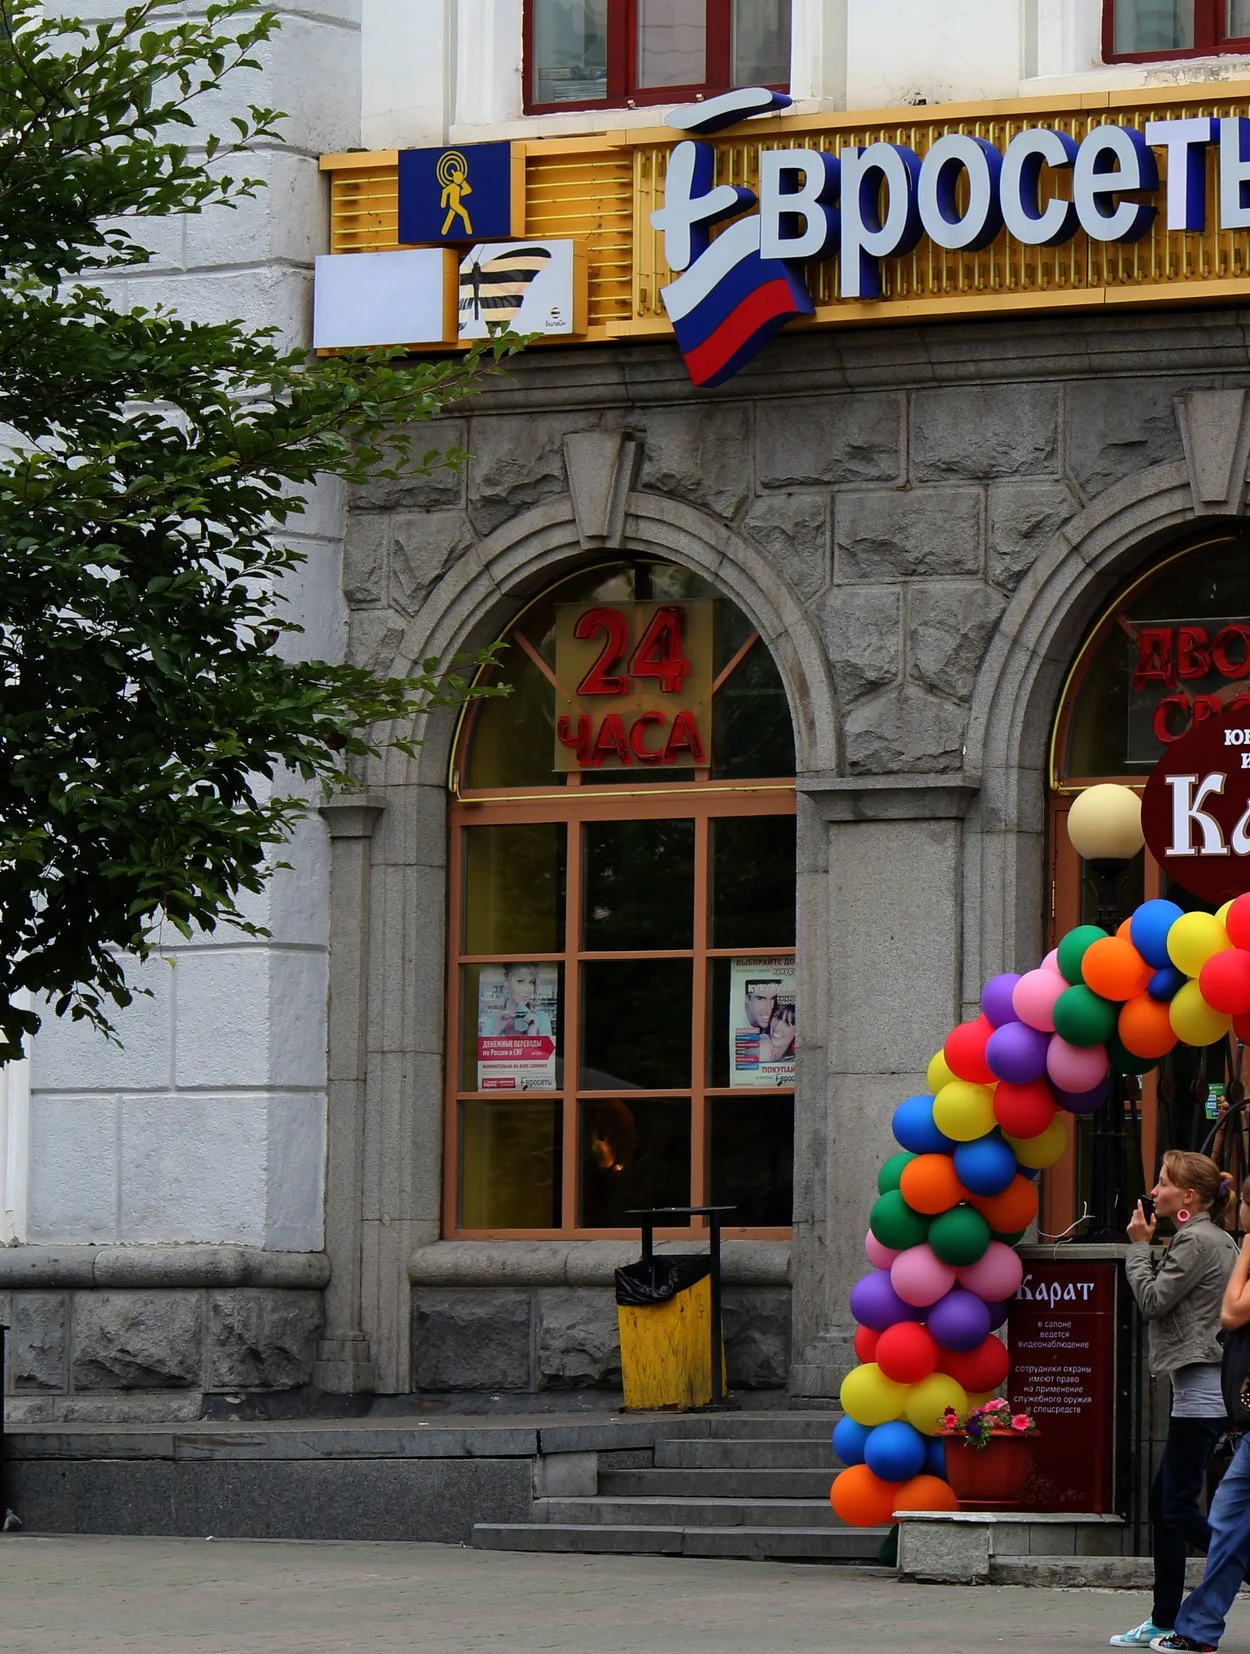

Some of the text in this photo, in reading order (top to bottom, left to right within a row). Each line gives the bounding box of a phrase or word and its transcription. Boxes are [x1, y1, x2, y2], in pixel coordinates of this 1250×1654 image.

[573, 605, 691, 696] 24
[557, 711, 706, 767] ЧАСА
[1015, 1274, 1095, 1309] Карат
[1018, 1340, 1090, 1348] видеонаблюдение
[1014, 1365, 1092, 1374] сотрудники охраны
[1056, 1376, 1080, 1384] право
[1035, 1386, 1084, 1394] применение
[1013, 1395, 1092, 1405] служебного оружия
[1033, 1406, 1081, 1414] спецсредств
